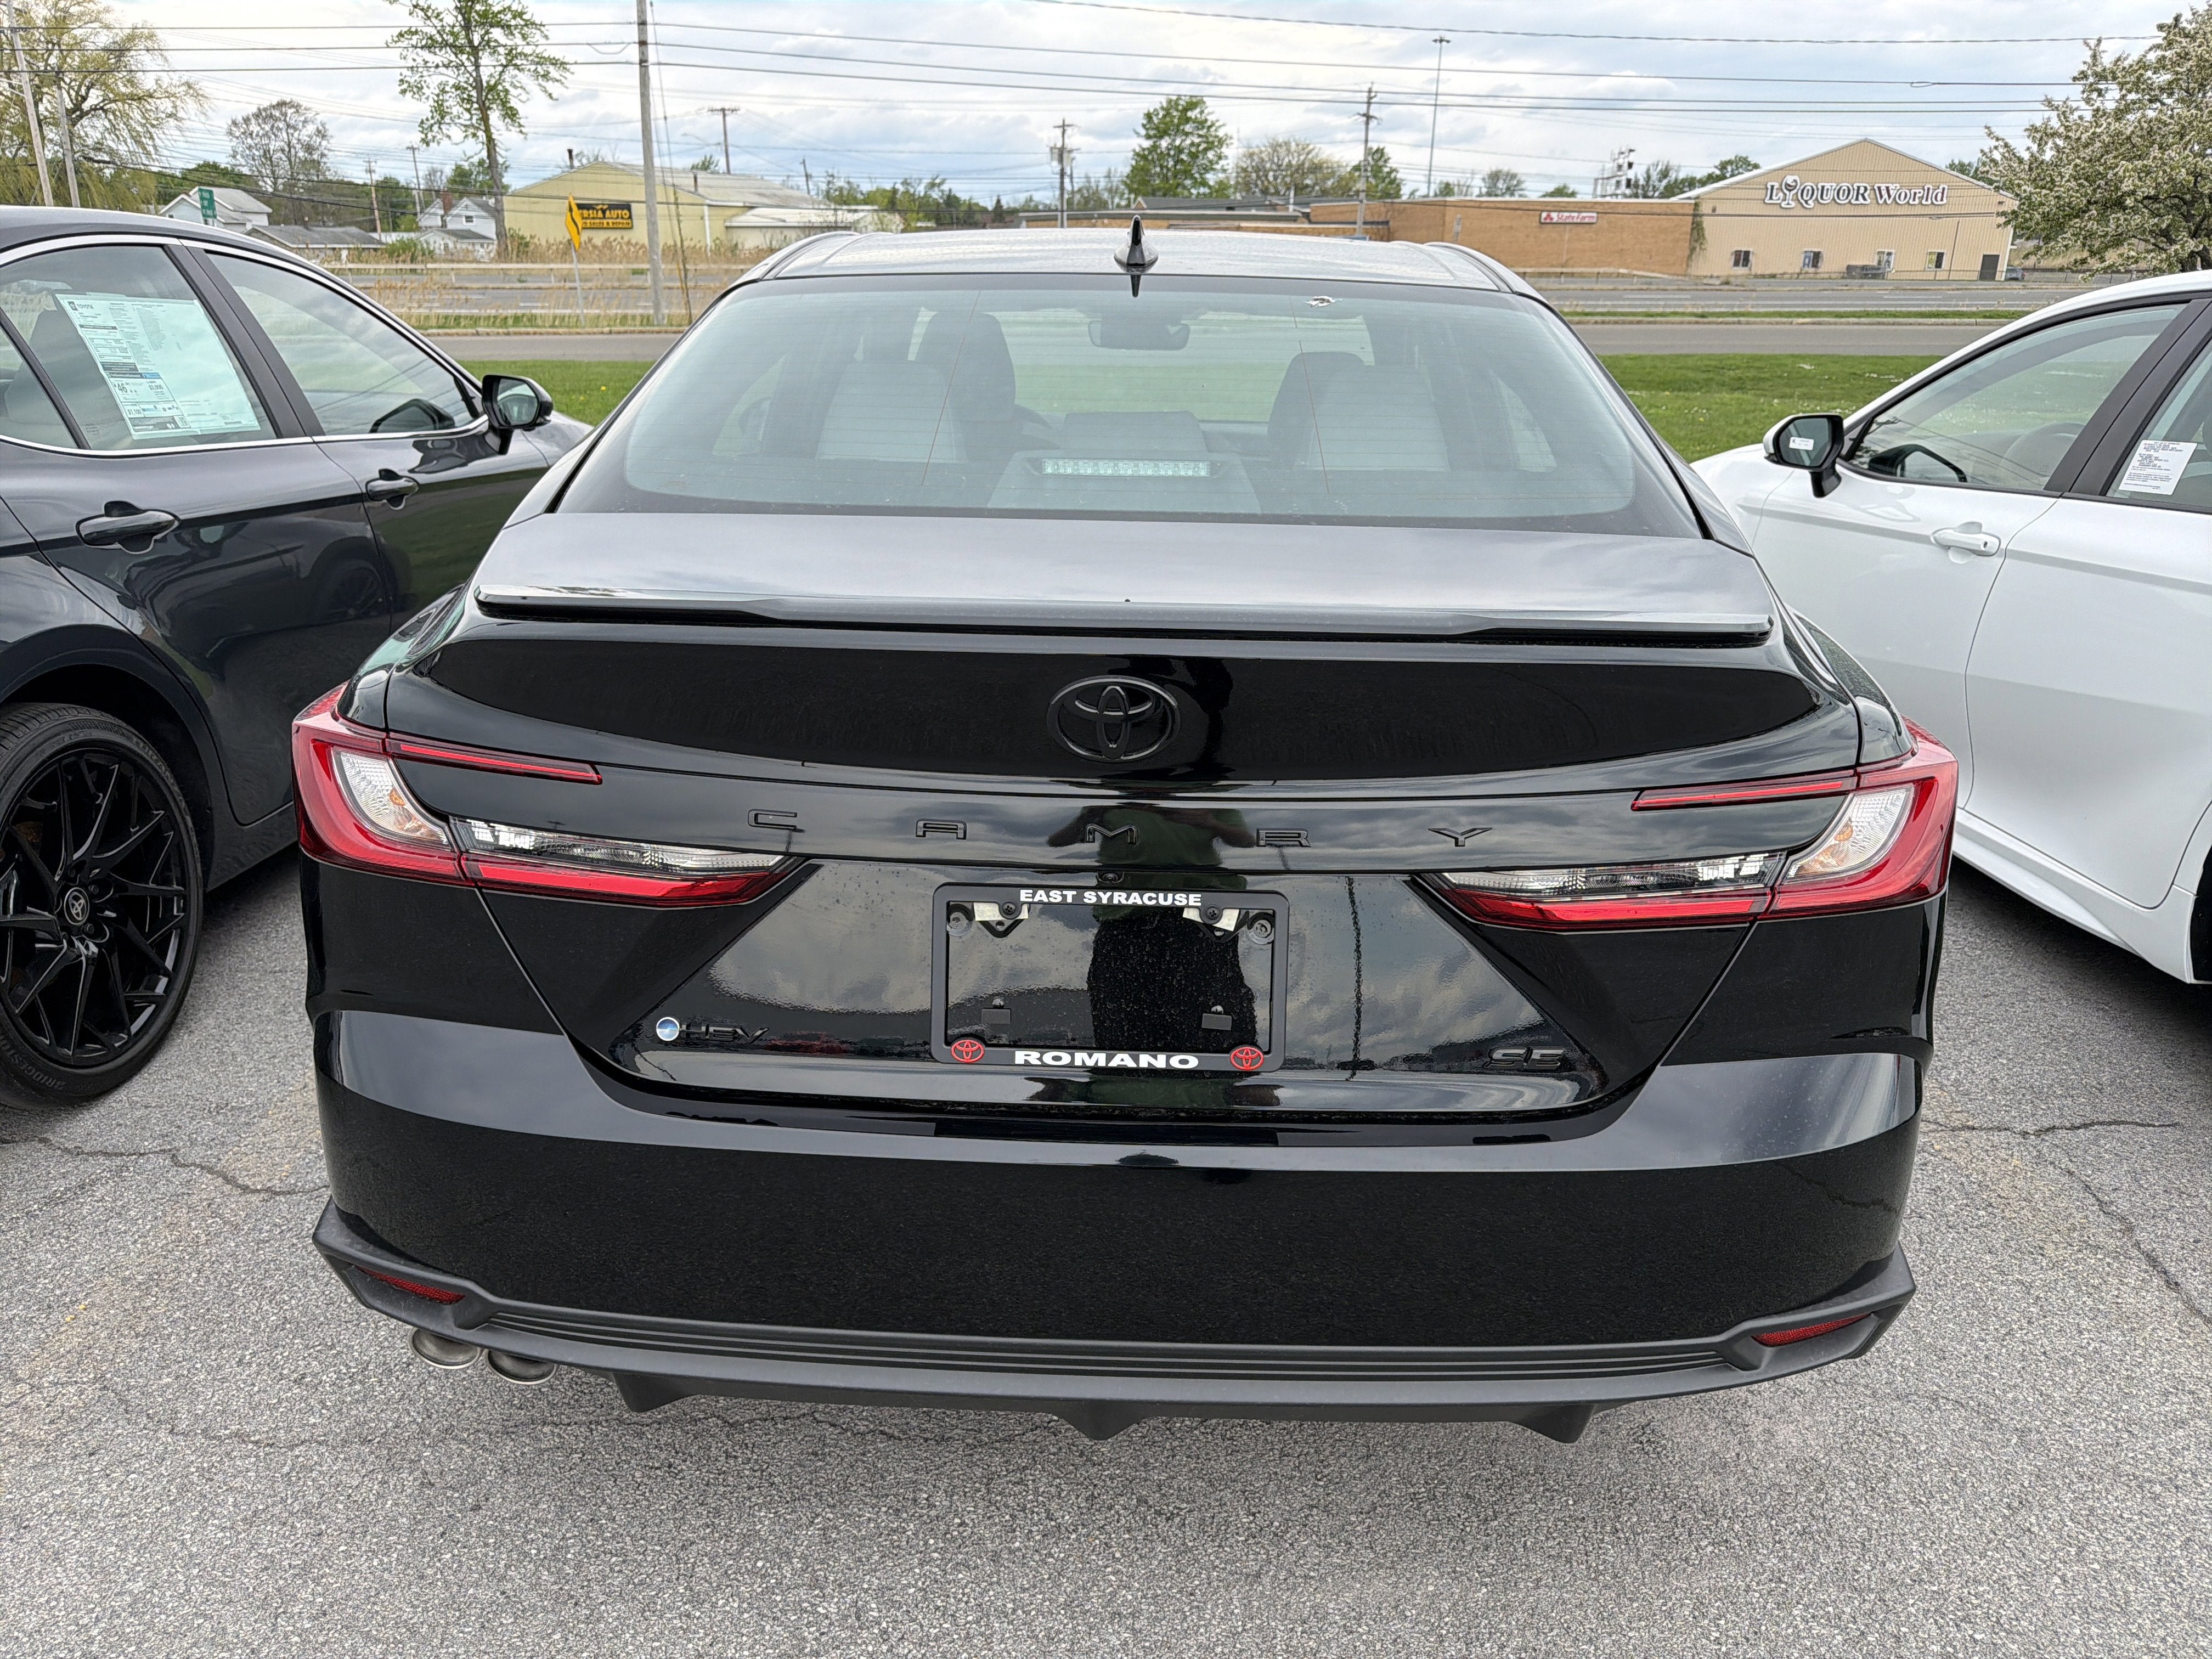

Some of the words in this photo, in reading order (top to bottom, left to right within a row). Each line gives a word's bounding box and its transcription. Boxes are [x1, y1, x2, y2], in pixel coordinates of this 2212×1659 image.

[1874, 183, 1948, 205] World
[605, 209, 630, 219] AUTO
[1556, 213, 1575, 222] State
[1576, 213, 1595, 222] Farm
[117, 382, 128, 393] 46
[747, 808, 1493, 848] CAMRY
[1019, 889, 1077, 904] EAST
[1082, 891, 1202, 907] SYRACUSE
[1014, 1050, 1199, 1069] ROMANO
[1483, 1046, 1565, 1070] SE
